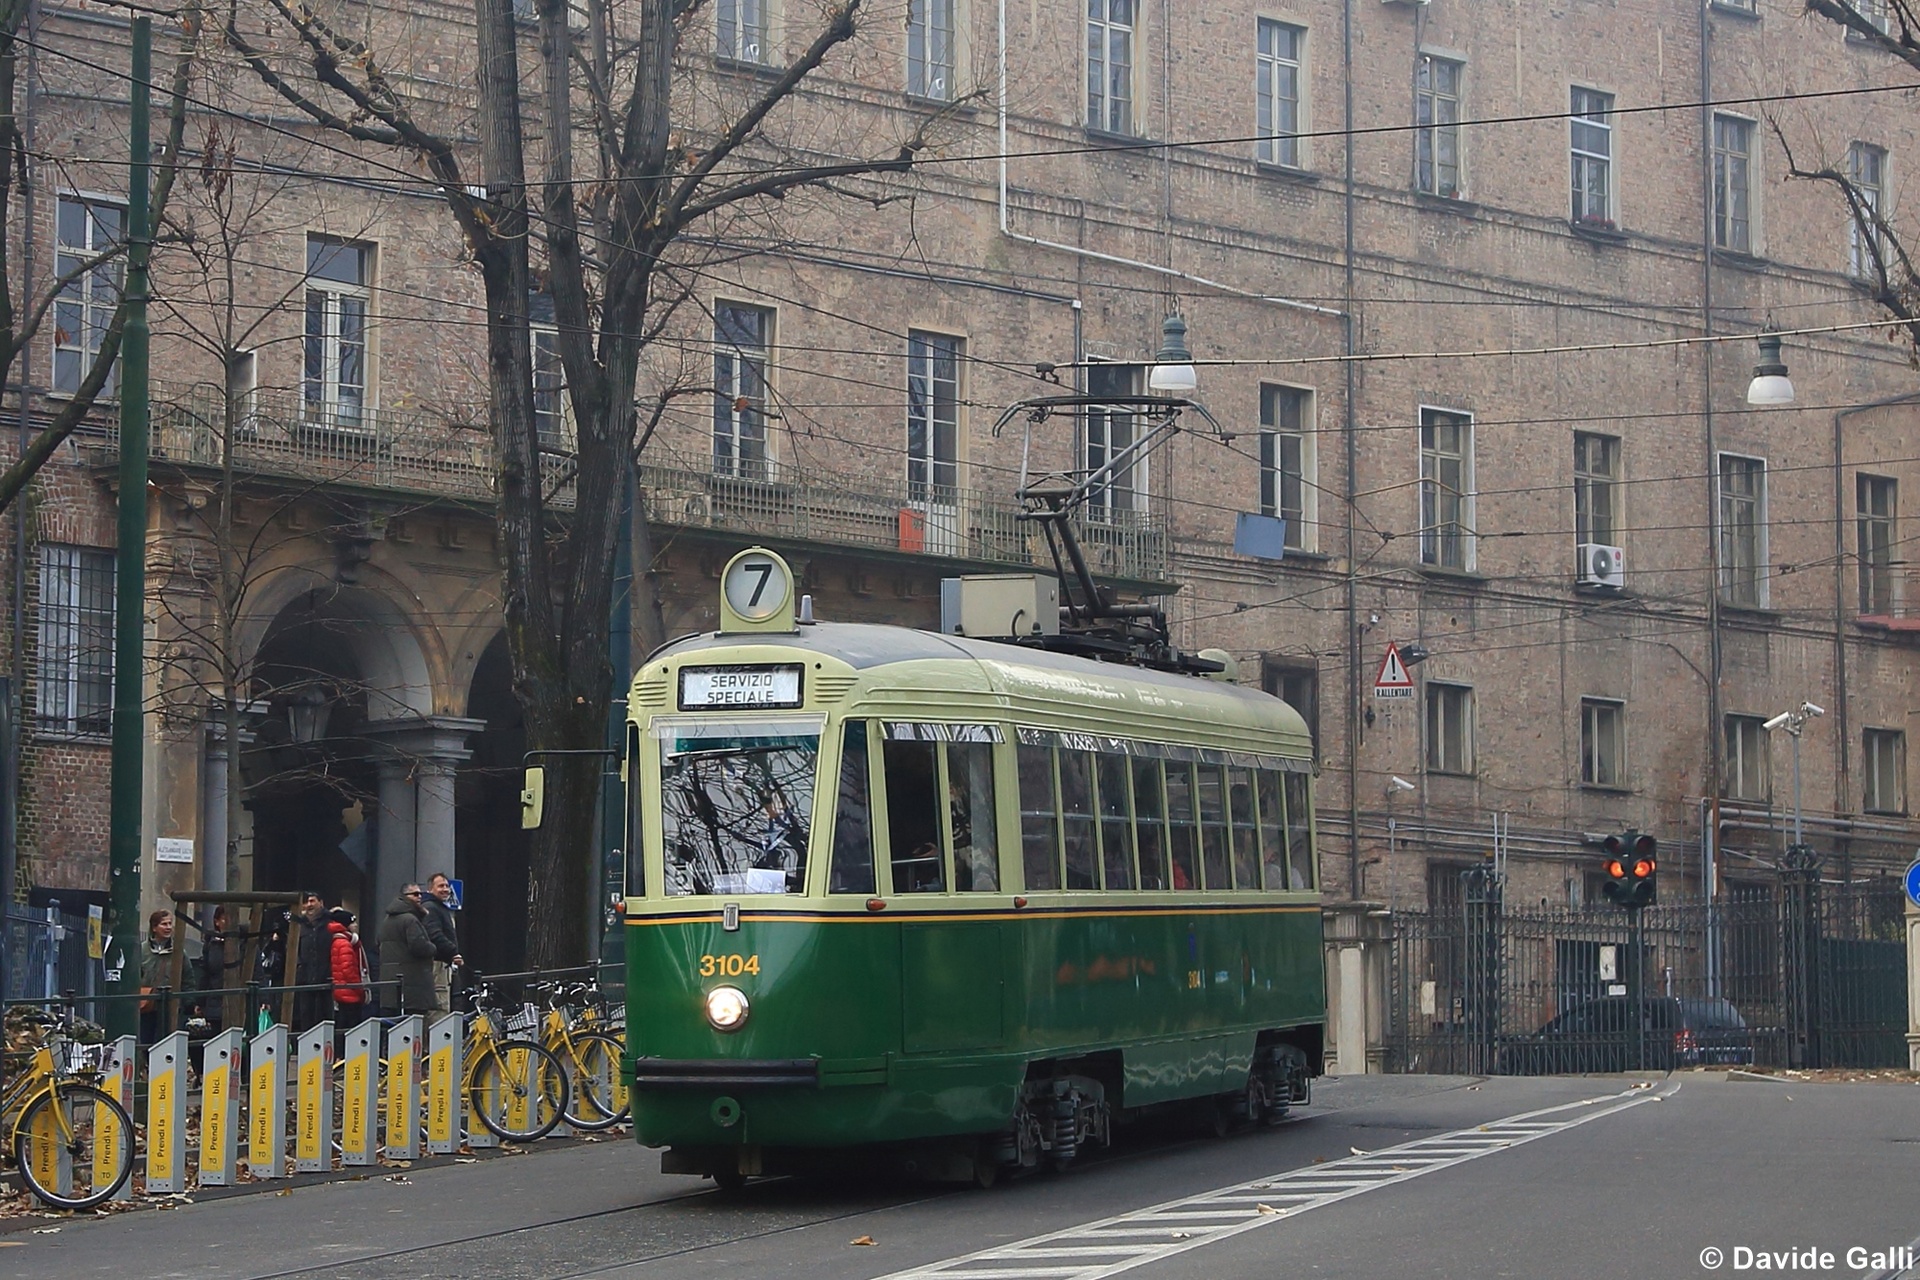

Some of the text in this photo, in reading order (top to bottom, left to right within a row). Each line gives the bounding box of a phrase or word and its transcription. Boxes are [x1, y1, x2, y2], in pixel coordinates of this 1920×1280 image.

[744, 563, 773, 607] 7
[710, 674, 773, 688] SERVIZIO
[707, 690, 774, 704] SPECIALE
[1376, 687, 1412, 698] RALLENTARE
[700, 954, 760, 977] 3104
[395, 1093, 403, 1101] la
[437, 1088, 445, 1096] la
[306, 1102, 314, 1111] la
[352, 1097, 360, 1106] la
[437, 1097, 445, 1123] Prendi
[210, 1112, 218, 1121] la
[258, 1107, 267, 1115] la
[395, 1102, 403, 1128] Prendi
[104, 1125, 111, 1134] la
[157, 1118, 165, 1127] la
[306, 1111, 314, 1140] Prendi
[351, 1107, 360, 1134] Prendi
[209, 1122, 218, 1151] Prendi
[258, 1116, 267, 1145] Prendi
[103, 1135, 111, 1165] Prendi
[157, 1128, 166, 1158] Prendi
[41, 1142, 49, 1173] Prendi
